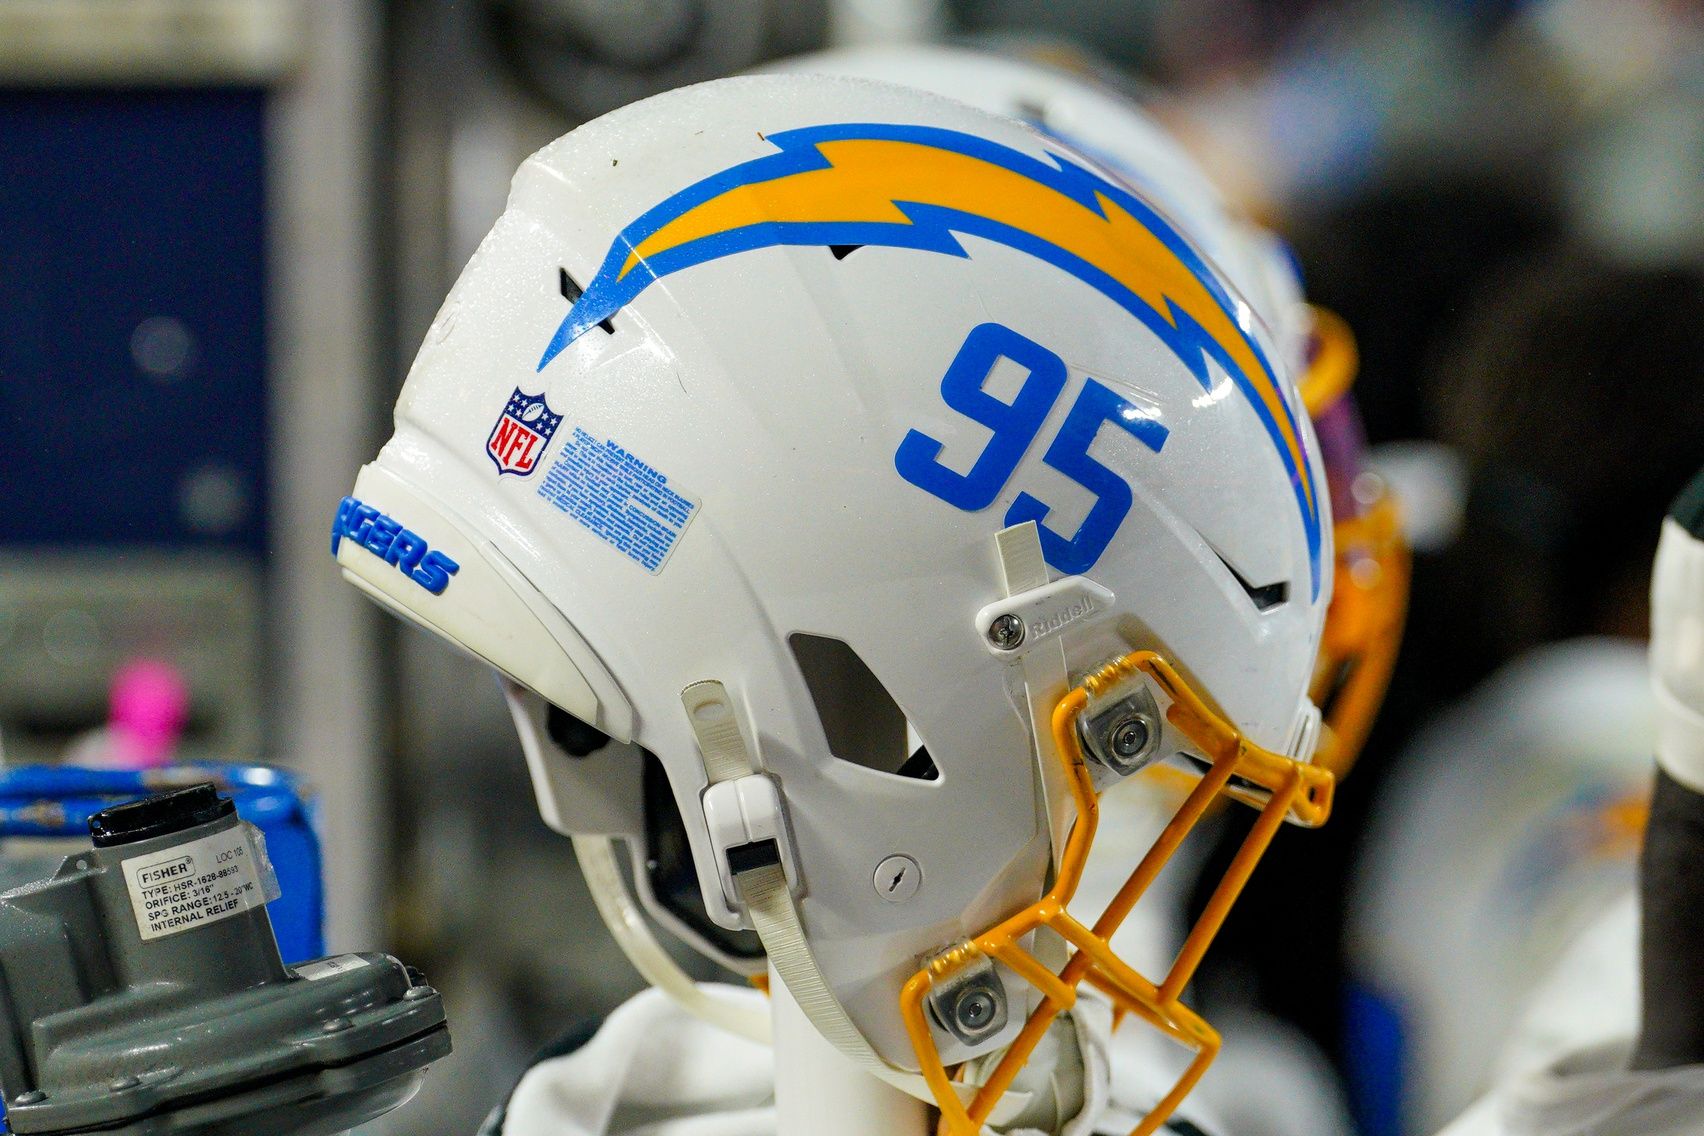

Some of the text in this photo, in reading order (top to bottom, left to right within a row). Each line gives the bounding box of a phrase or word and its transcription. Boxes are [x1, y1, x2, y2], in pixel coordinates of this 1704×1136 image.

[490, 416, 539, 470] NFL
[894, 322, 1170, 575] 95
[606, 439, 667, 484] WARNING
[1032, 592, 1095, 640] Riddell
[216, 849, 233, 864] LOC
[142, 885, 172, 900] TYPE:
[145, 891, 191, 910] ORIFICE:
[147, 908, 169, 921] SPG
[171, 897, 213, 918] RANGE:
[151, 898, 240, 932] INTERNAL RELIEF
